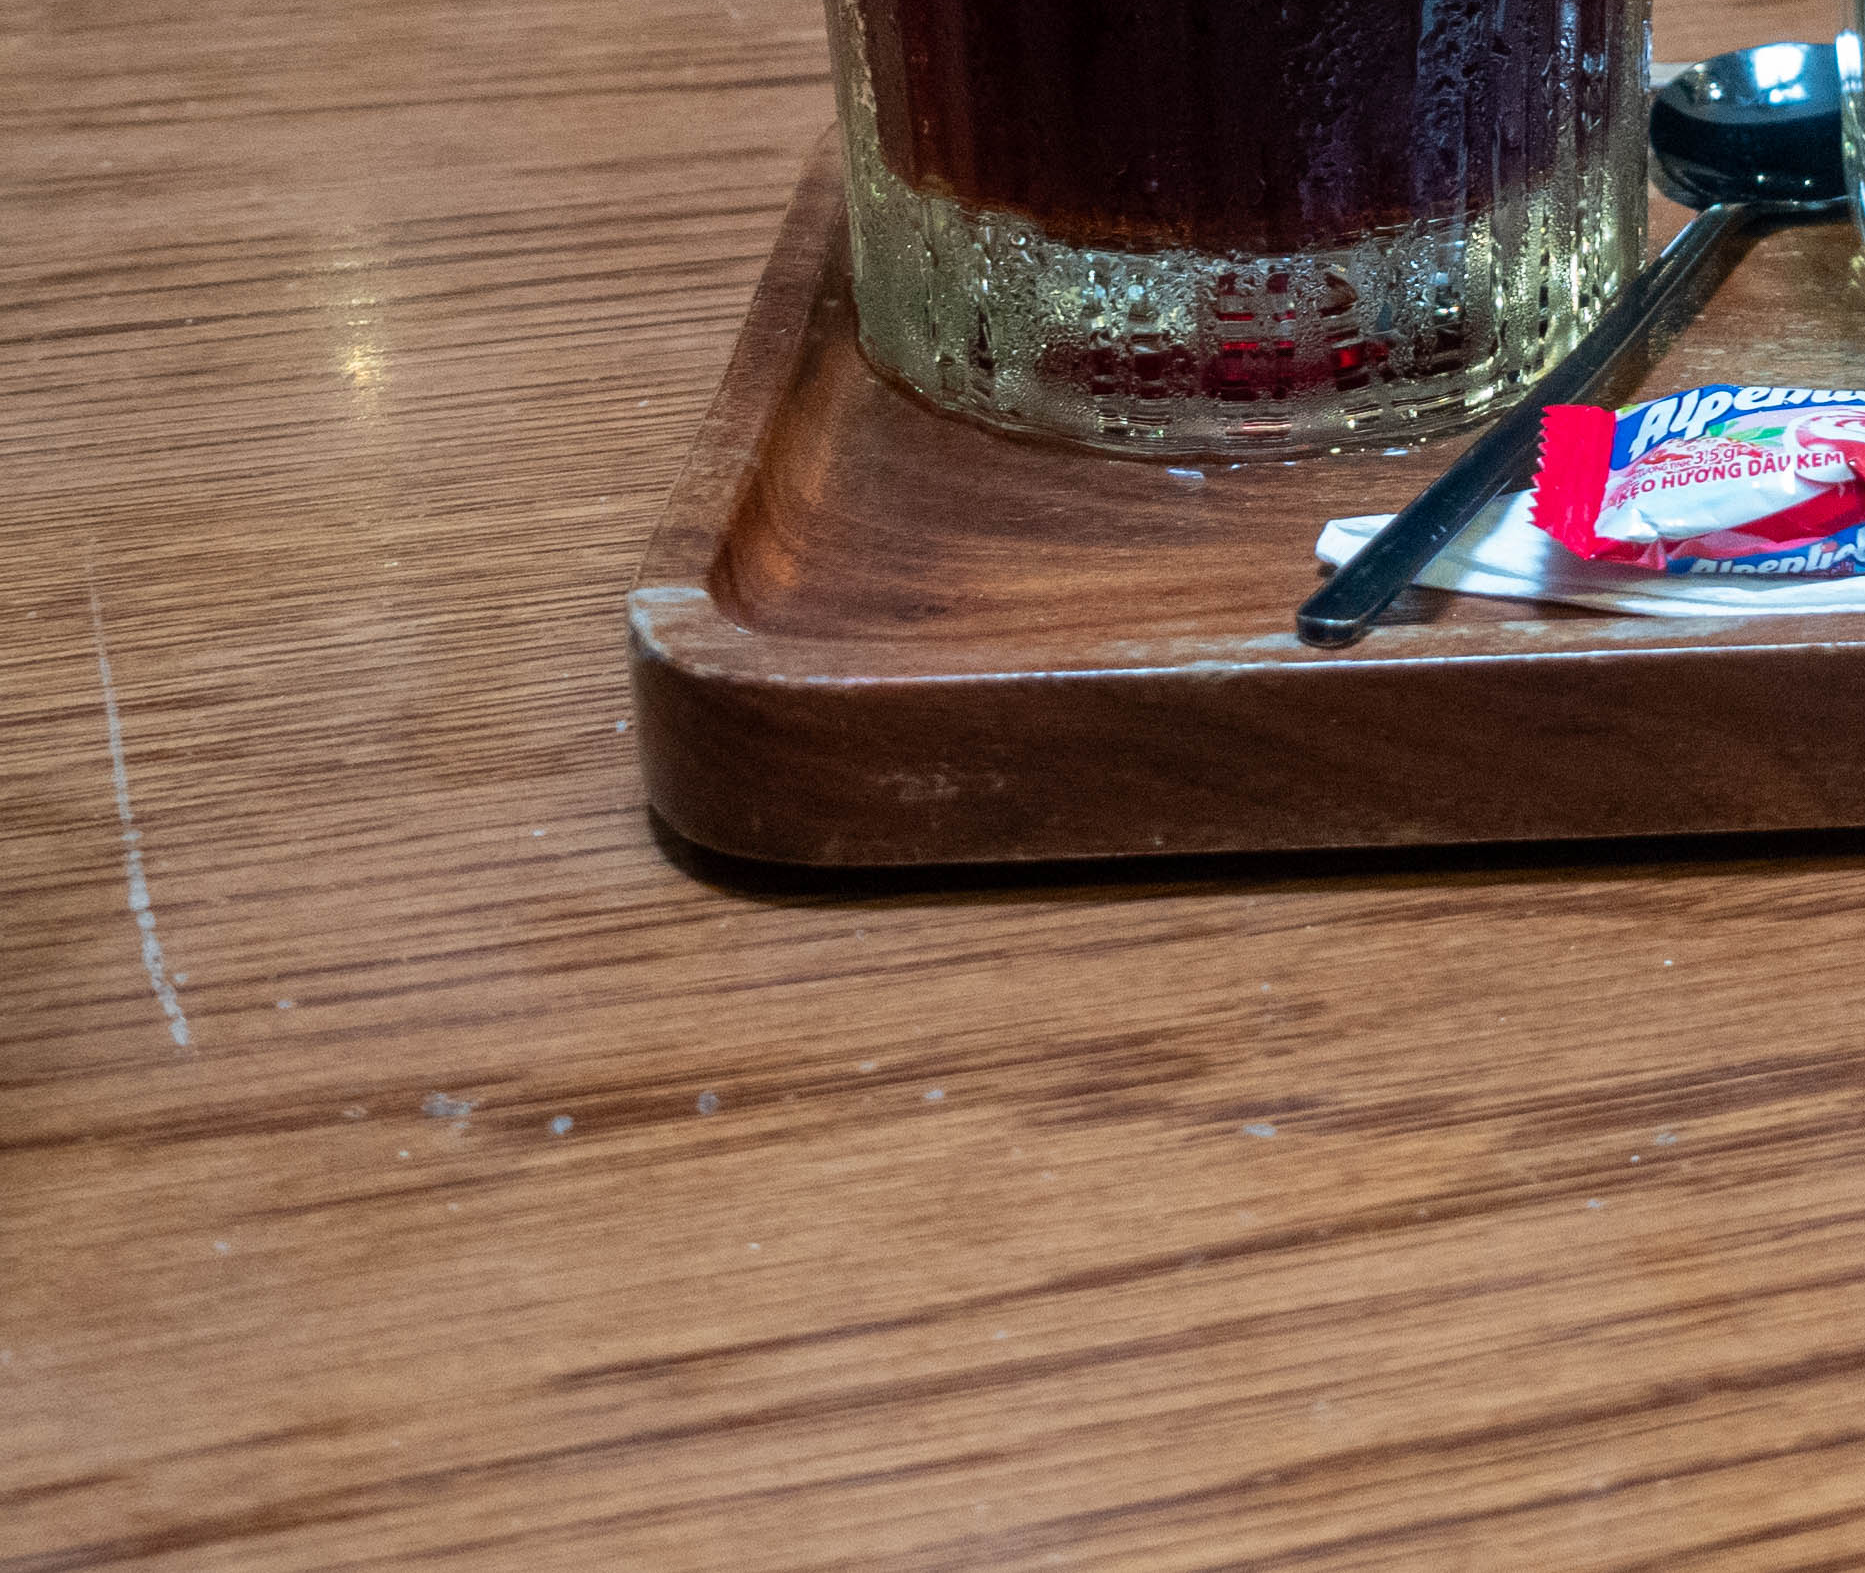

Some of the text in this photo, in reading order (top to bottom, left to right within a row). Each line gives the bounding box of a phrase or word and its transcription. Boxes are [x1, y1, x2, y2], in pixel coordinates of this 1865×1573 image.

[1660, 462, 1741, 489] HƯƠNG
[1748, 451, 1791, 477] DÂU
[1796, 452, 1841, 470] KEM
